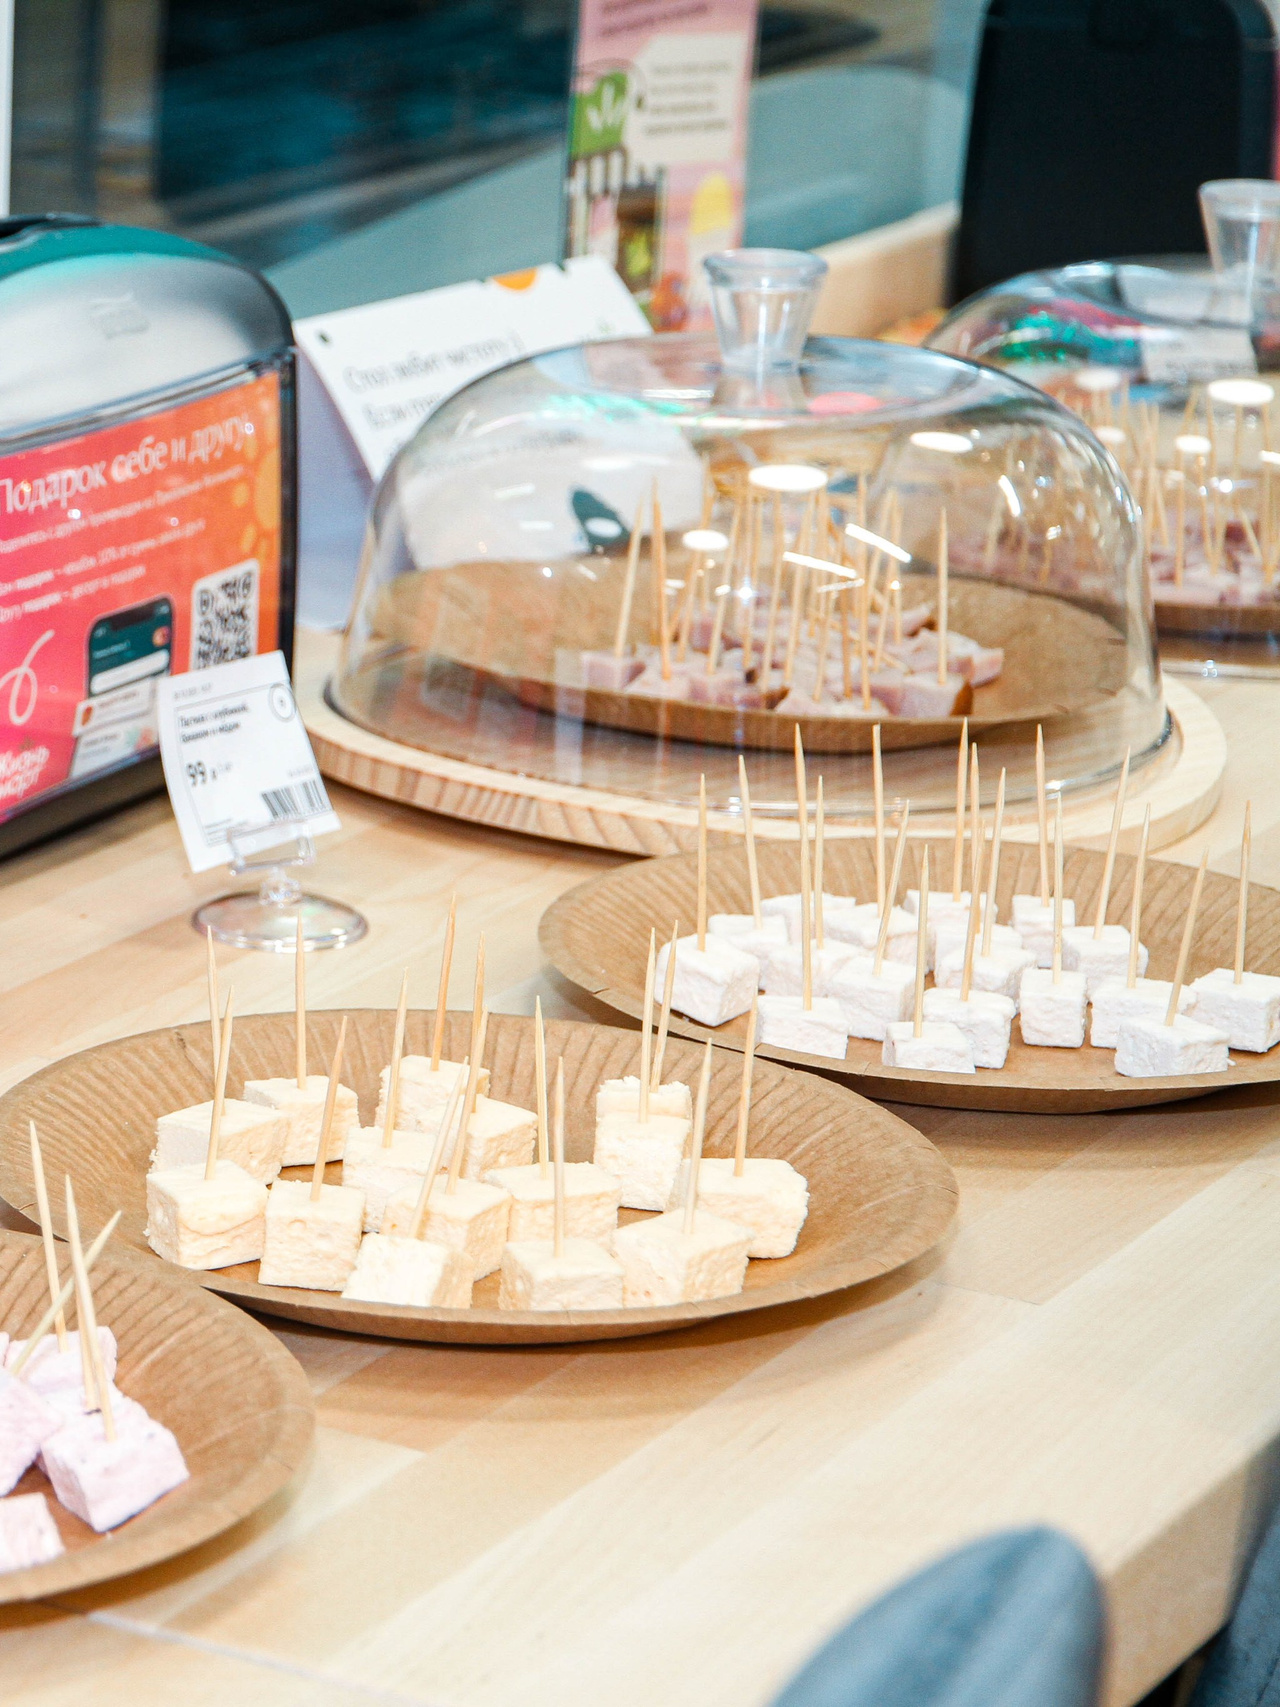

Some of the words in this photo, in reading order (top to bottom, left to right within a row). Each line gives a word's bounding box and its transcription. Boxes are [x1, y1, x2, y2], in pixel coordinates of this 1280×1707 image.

[111, 435, 168, 483] себе
[171, 438, 187, 462] и
[186, 760, 207, 786] 99
